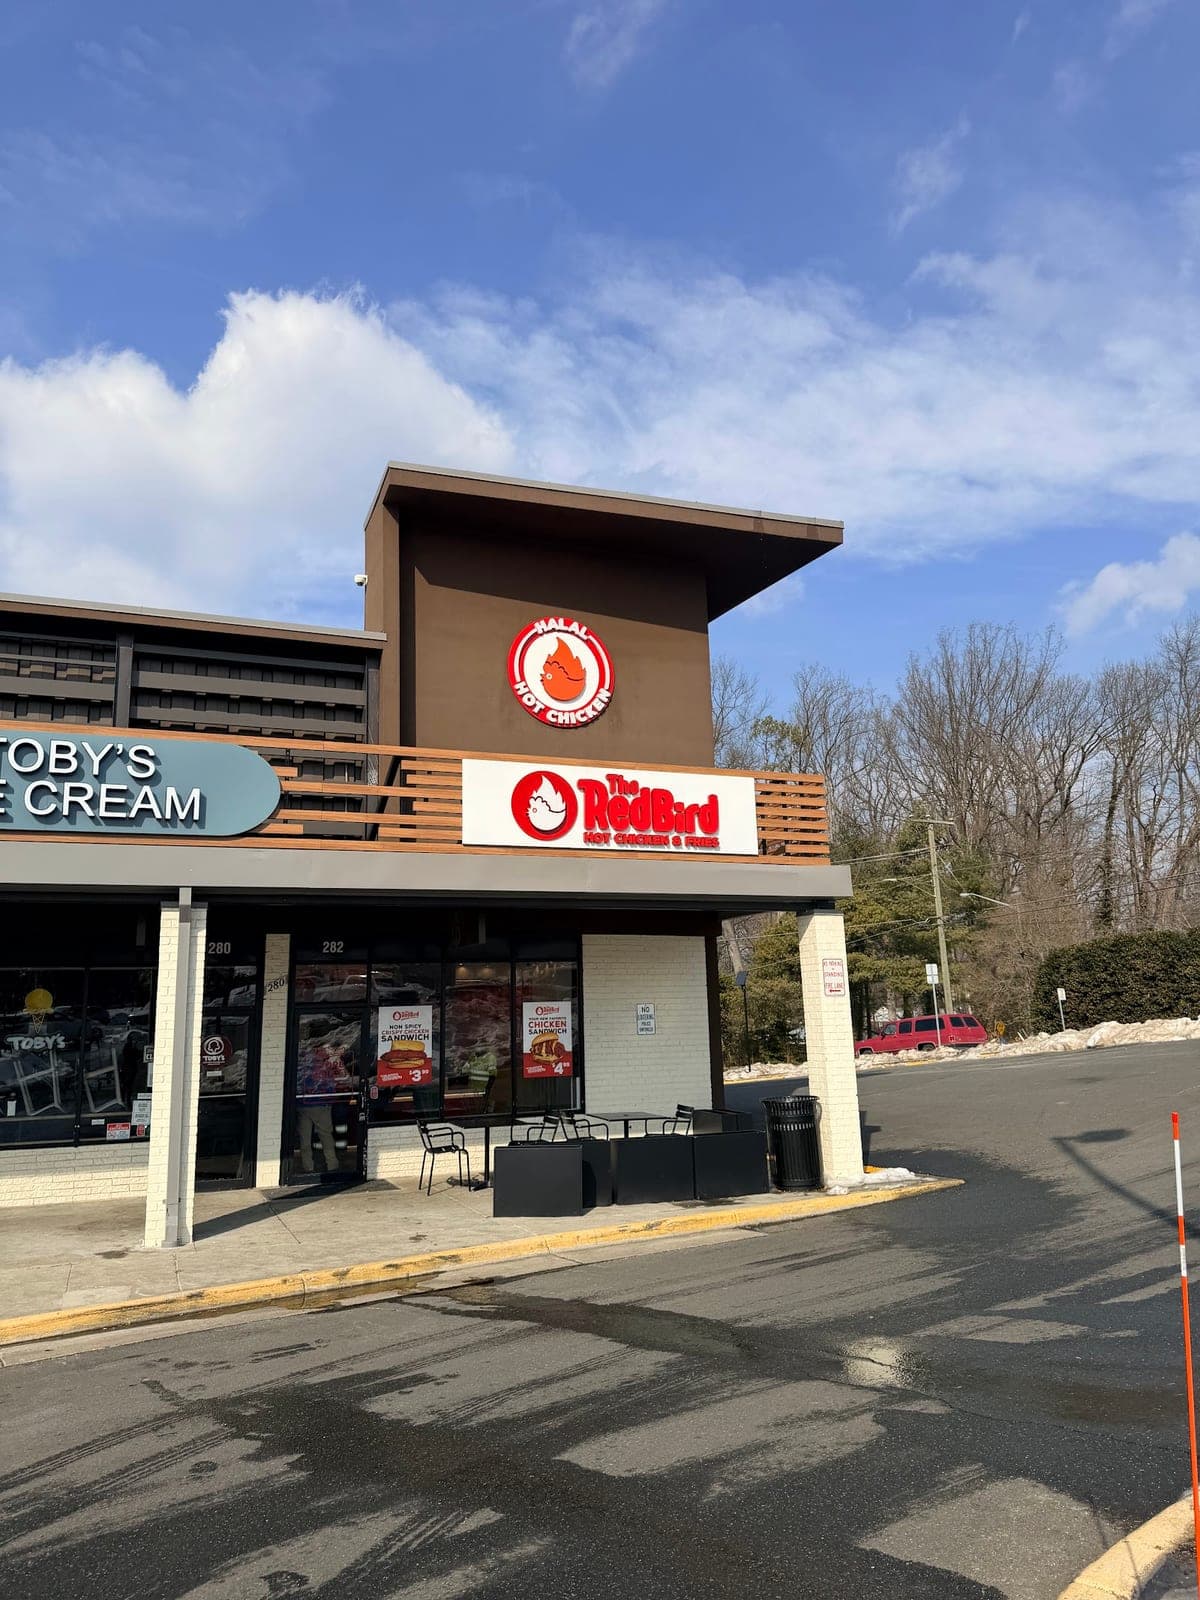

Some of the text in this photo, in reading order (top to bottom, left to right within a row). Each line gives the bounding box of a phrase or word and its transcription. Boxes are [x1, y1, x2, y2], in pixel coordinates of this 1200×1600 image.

[534, 618, 589, 640] HALAL
[514, 681, 611, 724] HOT CHICKEN
[0, 737, 156, 778] OBY'S
[606, 774, 639, 795] The
[24, 780, 200, 820] CREAM
[577, 779, 719, 834] RedBird
[583, 832, 720, 848] HOT CHICKEN & FRIES
[208, 942, 231, 954] 280
[322, 941, 344, 953] 282
[267, 979, 285, 993] 280
[641, 1006, 651, 1014] NO
[528, 1020, 567, 1028] CHICKEN
[6, 1033, 66, 1050] TOBY'S
[381, 1034, 430, 1042] SANDWICH
